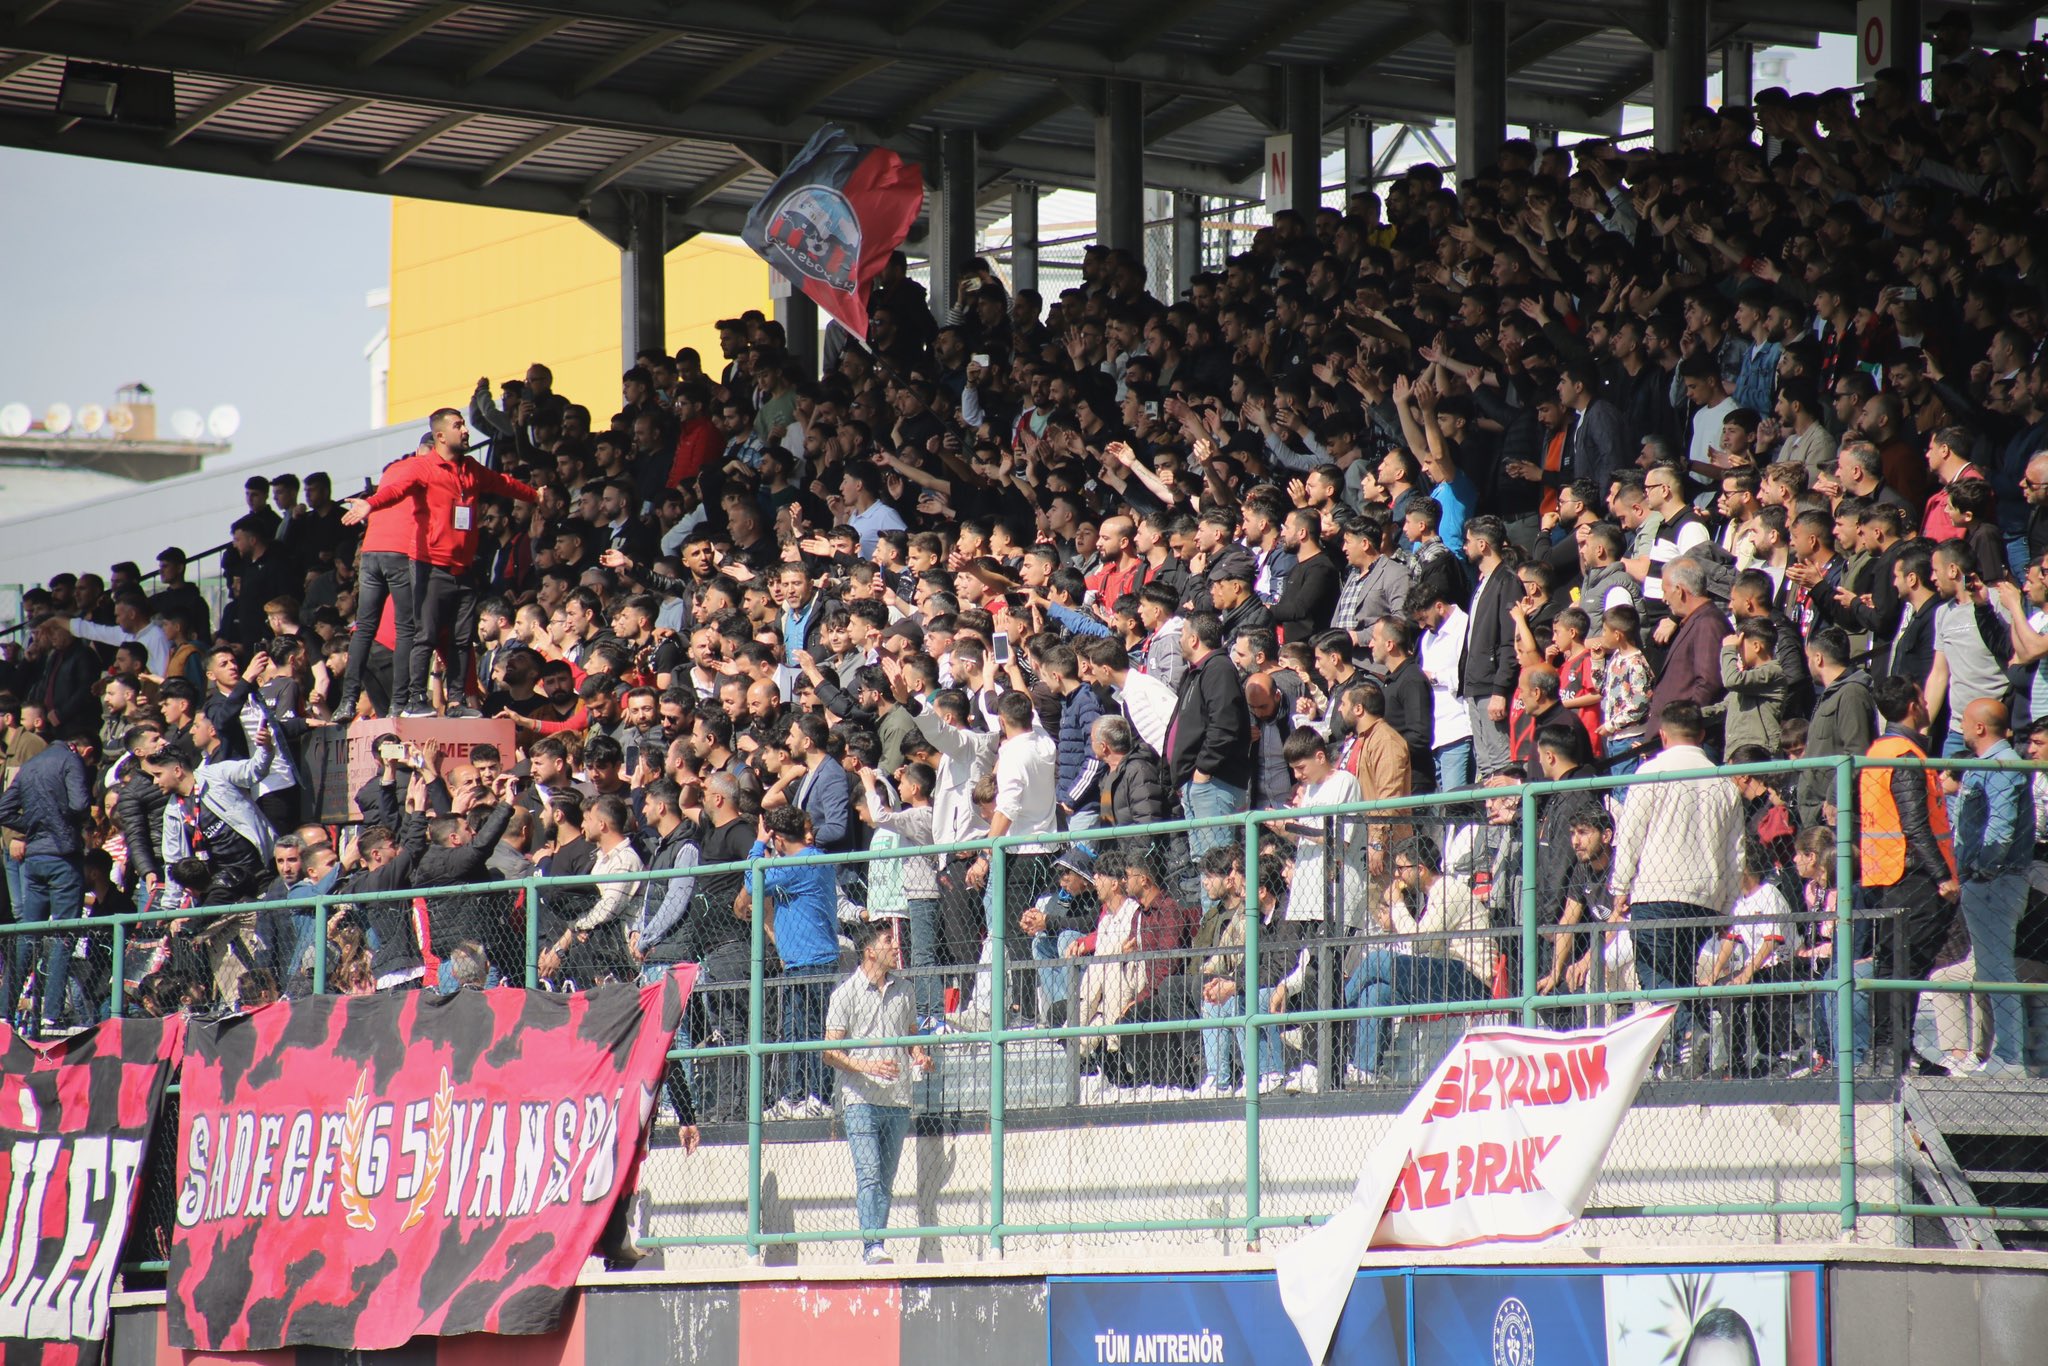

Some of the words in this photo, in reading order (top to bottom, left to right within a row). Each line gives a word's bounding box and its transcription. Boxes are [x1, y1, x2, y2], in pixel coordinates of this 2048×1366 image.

[1864, 16, 1884, 66] O
[1271, 151, 1286, 196] N
[355, 1099, 430, 1200] 65
[1094, 1328, 1130, 1364] TÜM
[1134, 1328, 1224, 1364] ANTRENÖR
